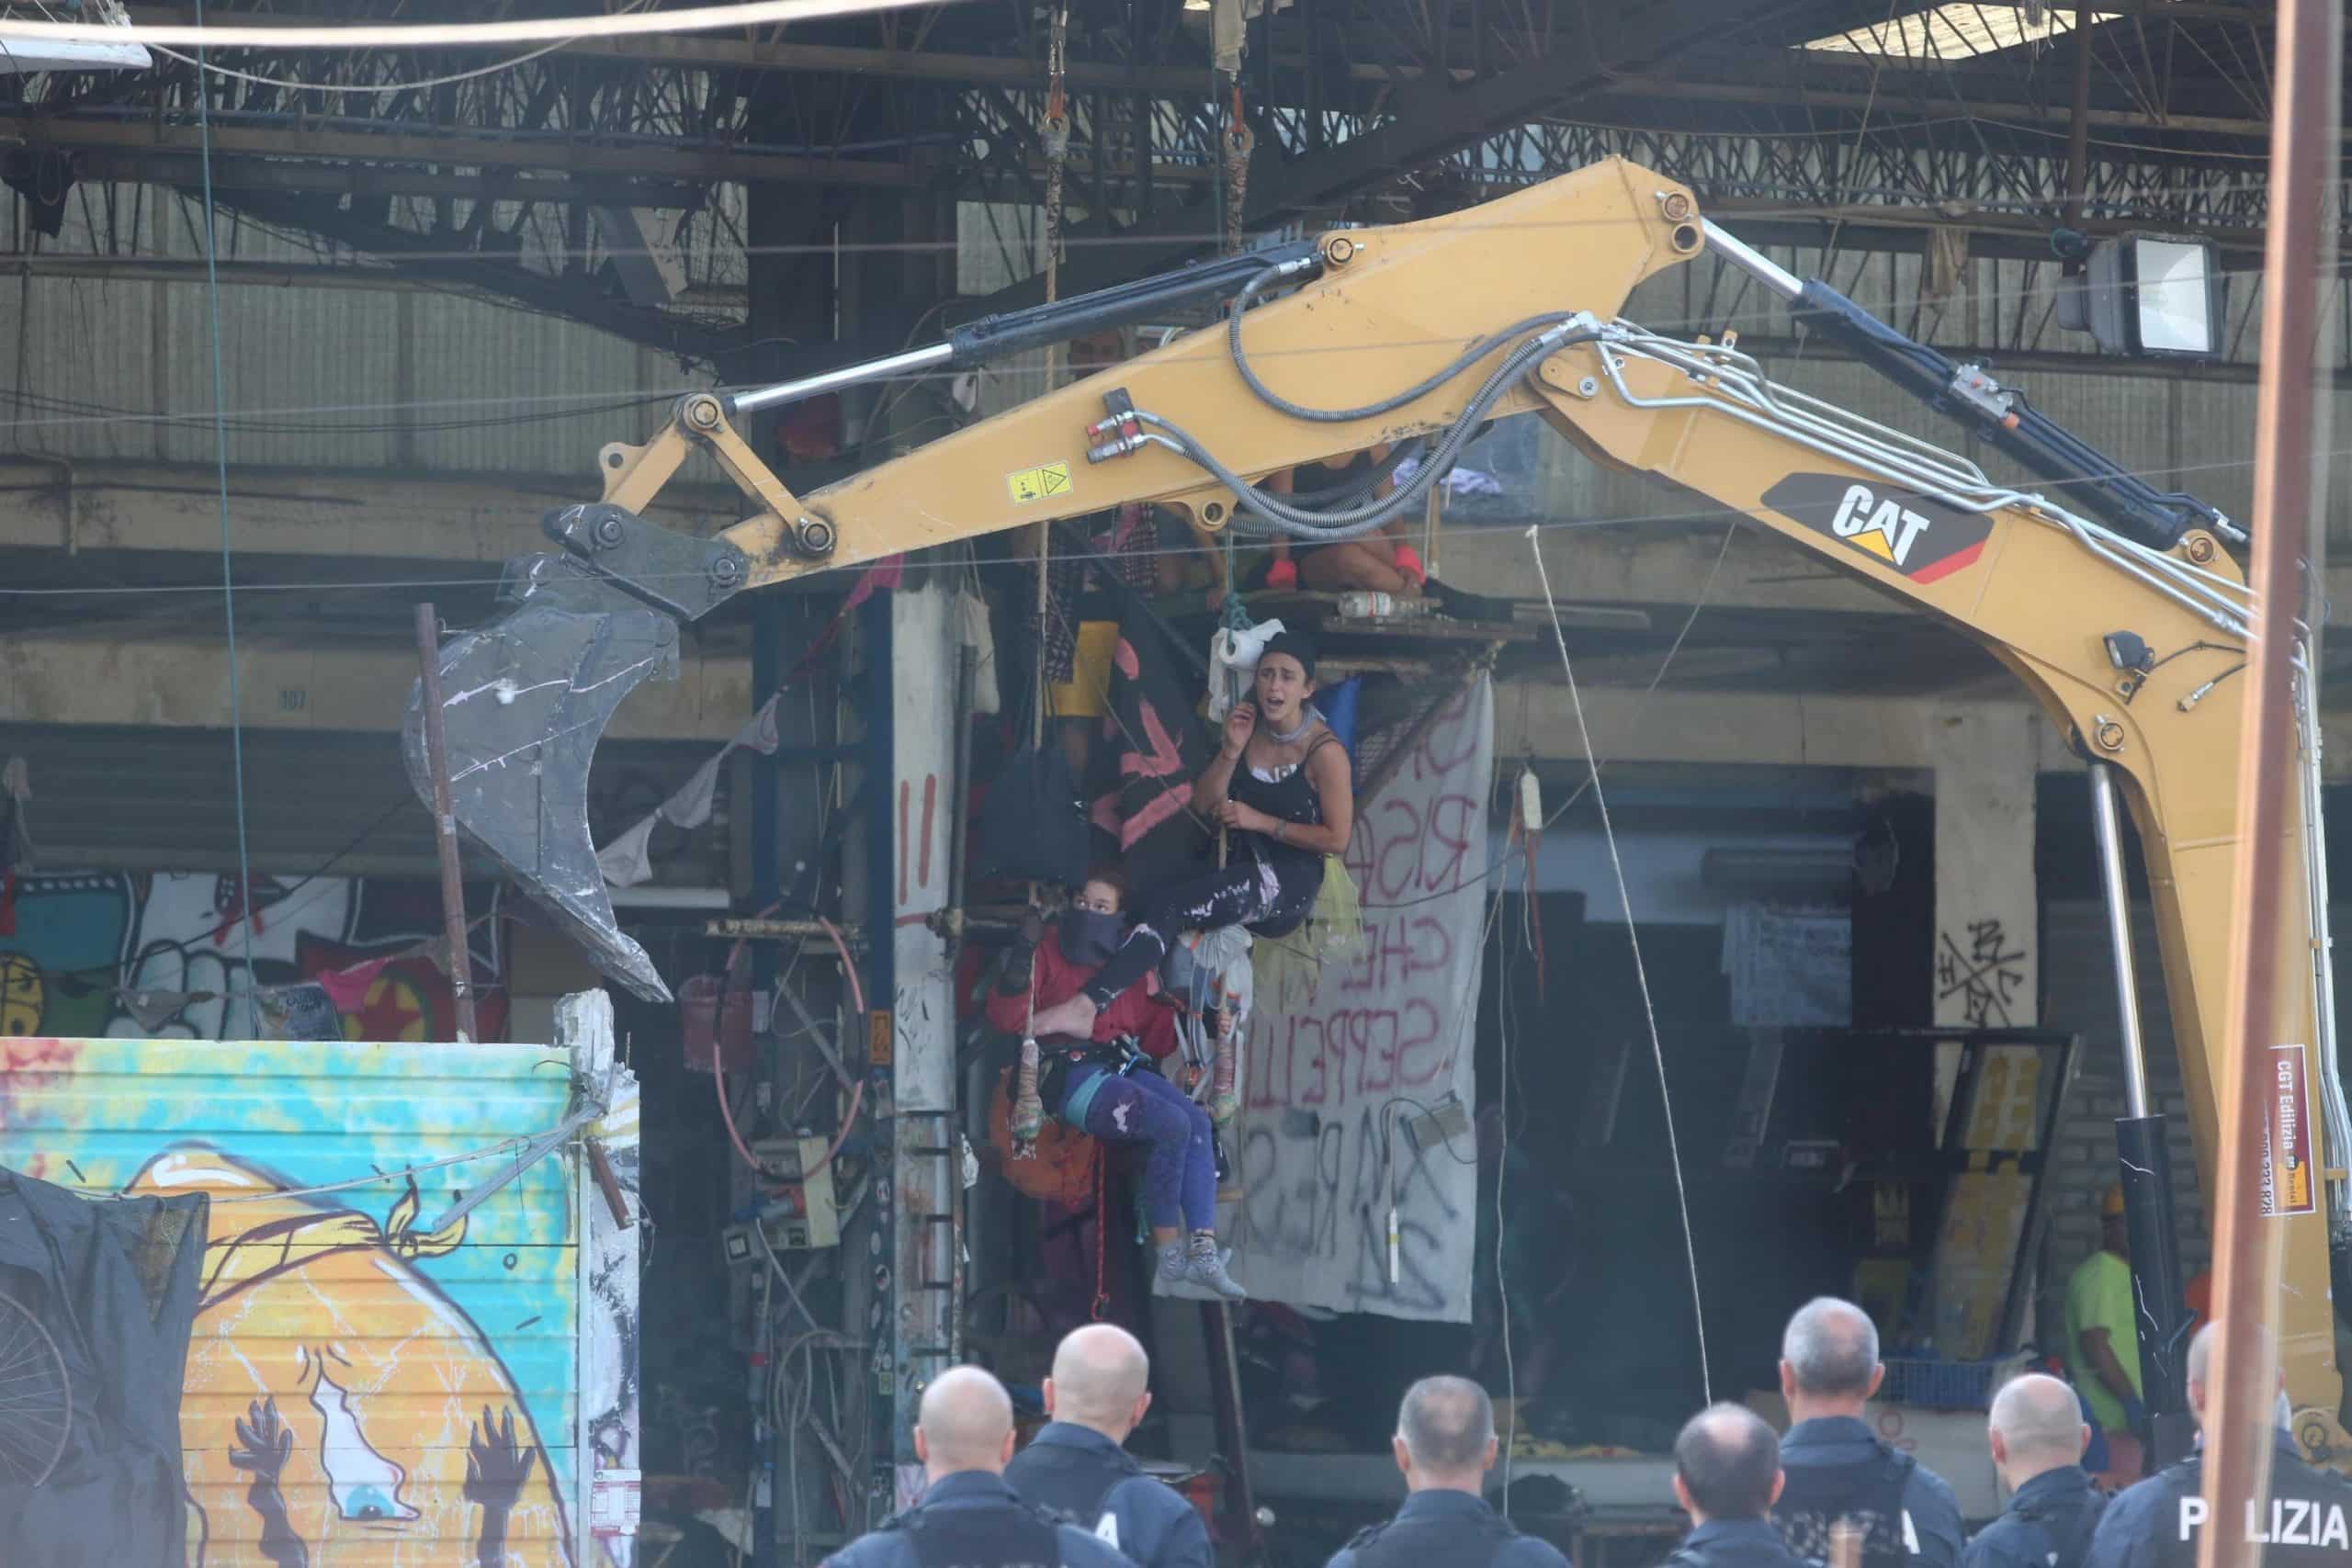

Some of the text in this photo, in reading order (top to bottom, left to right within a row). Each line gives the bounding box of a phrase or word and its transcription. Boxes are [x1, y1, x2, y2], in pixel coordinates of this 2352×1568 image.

[1832, 484, 1930, 567] CAT
[2278, 1060, 2293, 1090] CGT
[2279, 1095, 2297, 1150] Edilizia
[2178, 1495, 2349, 1551] PLIZIA
